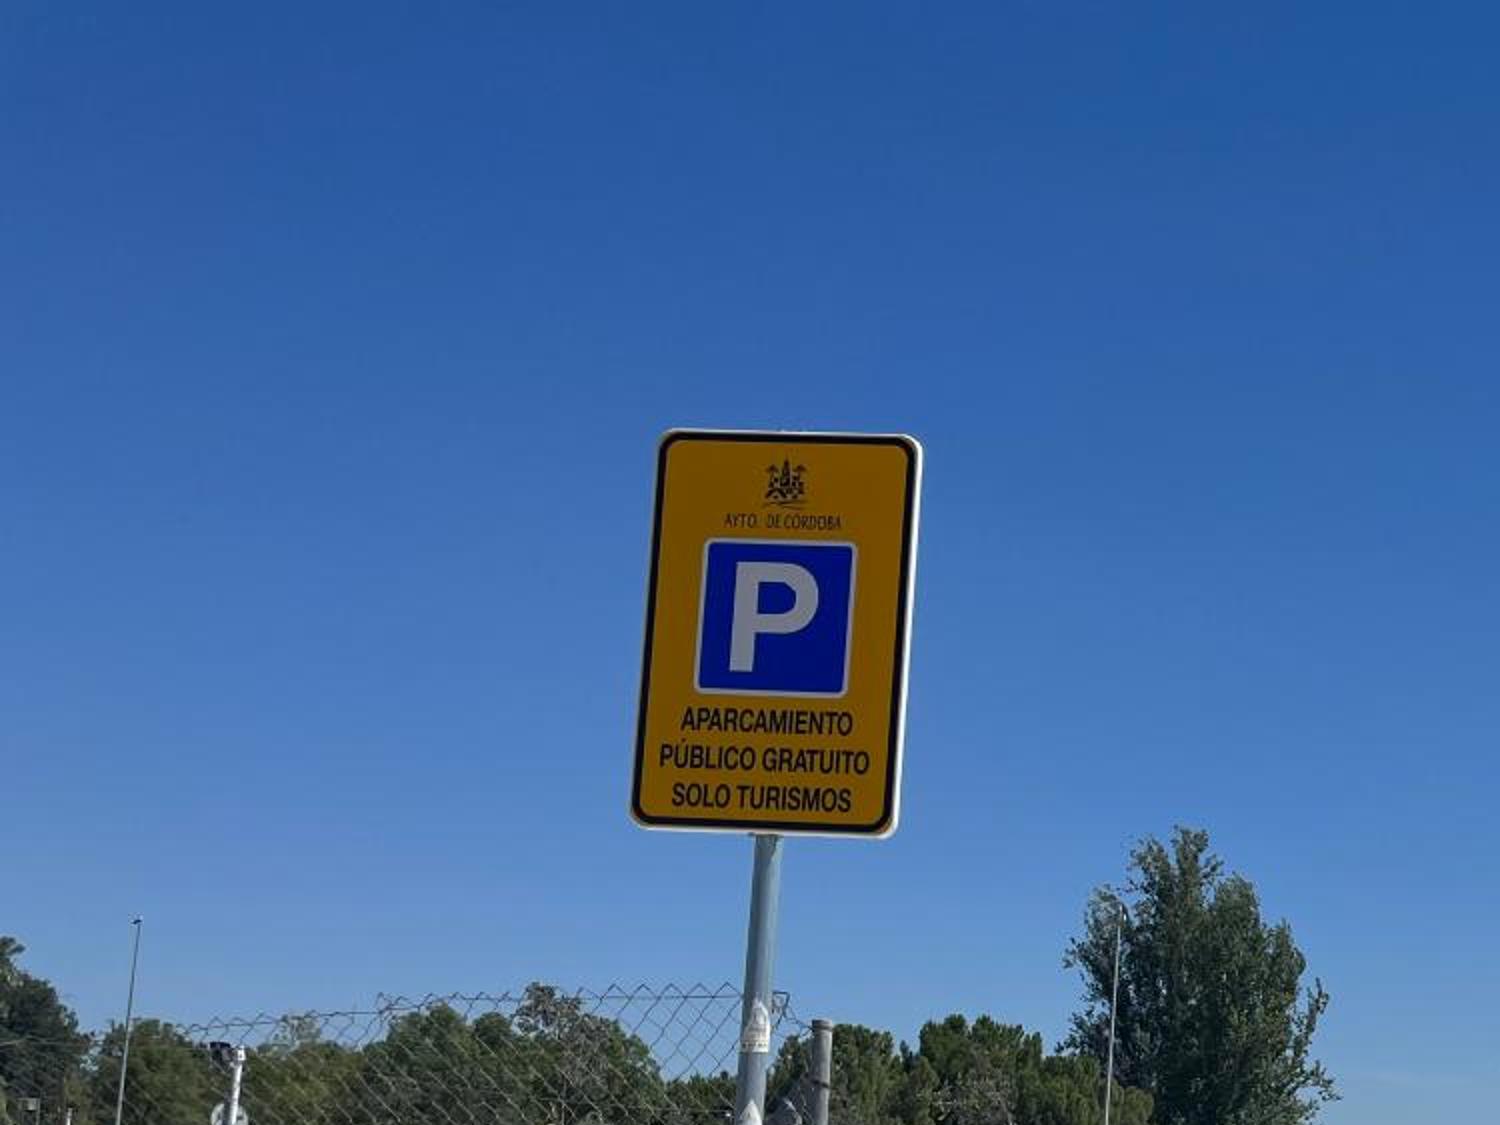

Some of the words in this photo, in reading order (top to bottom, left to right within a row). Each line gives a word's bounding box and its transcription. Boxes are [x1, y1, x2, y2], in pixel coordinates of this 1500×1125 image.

[767, 513, 781, 529] DE
[730, 562, 819, 672] P
[681, 707, 853, 736] APARCAMIENTO
[660, 738, 755, 771] PÚBLICO
[762, 750, 870, 775] GRATUITO
[672, 783, 731, 808] SOLO
[737, 785, 851, 812] TURISMOS
